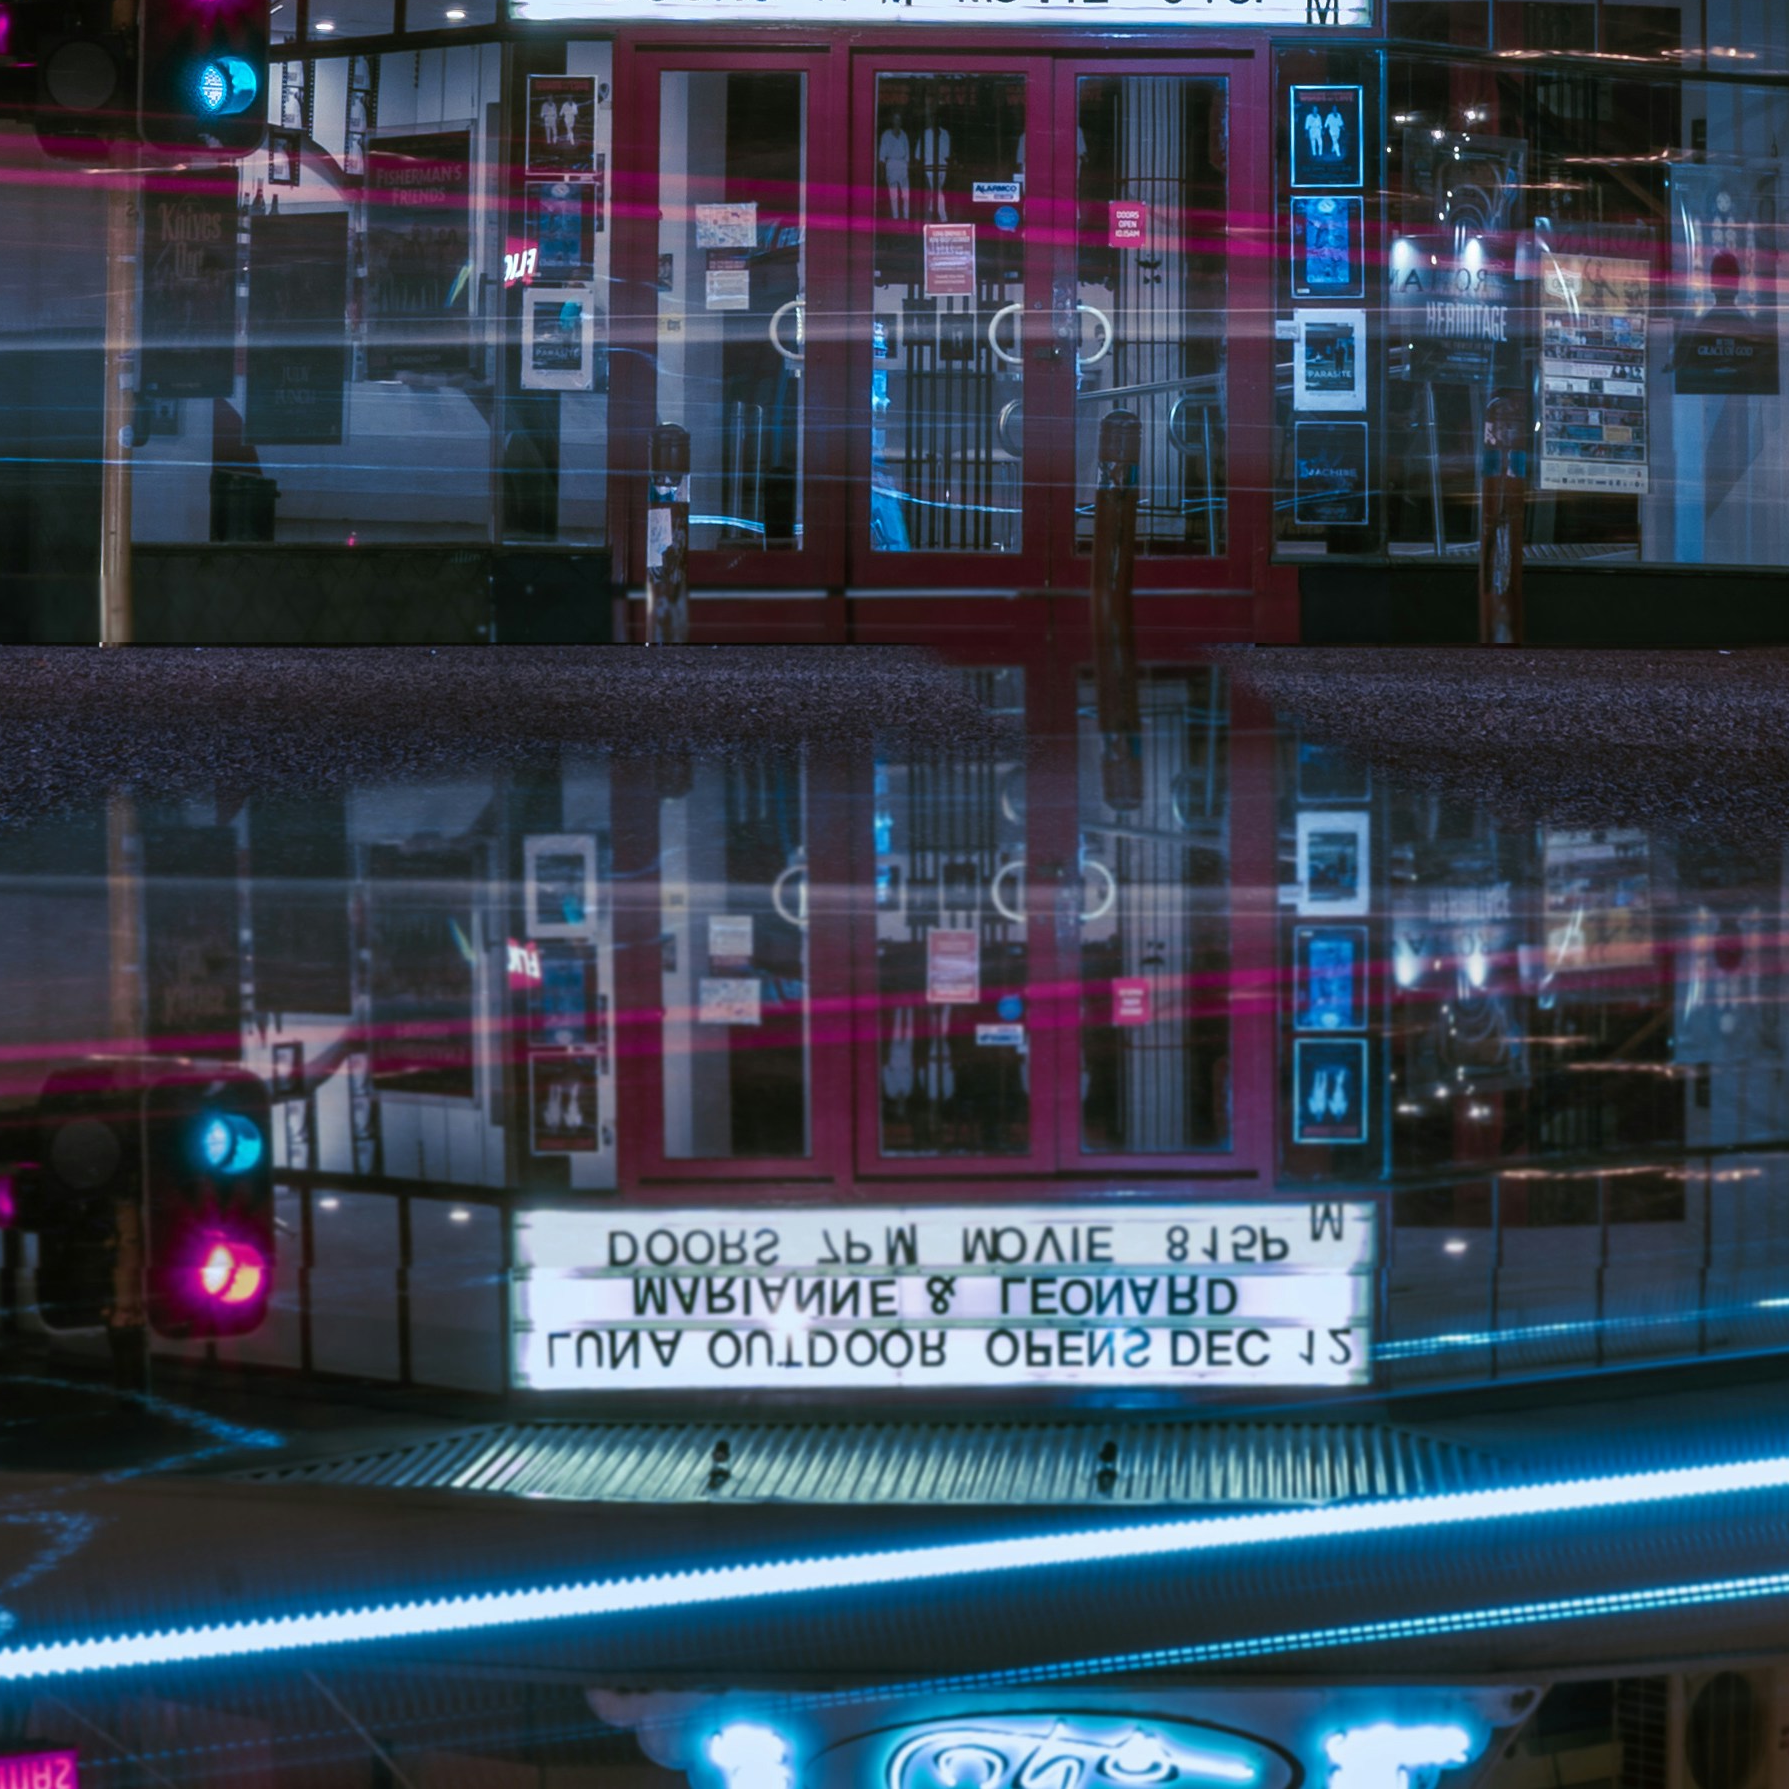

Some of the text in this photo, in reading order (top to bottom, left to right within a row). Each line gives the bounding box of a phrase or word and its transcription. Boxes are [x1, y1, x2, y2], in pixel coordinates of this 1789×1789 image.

[376, 165, 463, 188] FISHERMAN'S
[391, 187, 447, 207] FRIENDS
[1116, 211, 1139, 219] DOORS
[1118, 220, 1137, 228] OPEN
[1426, 301, 1508, 342] HERMITAGE
